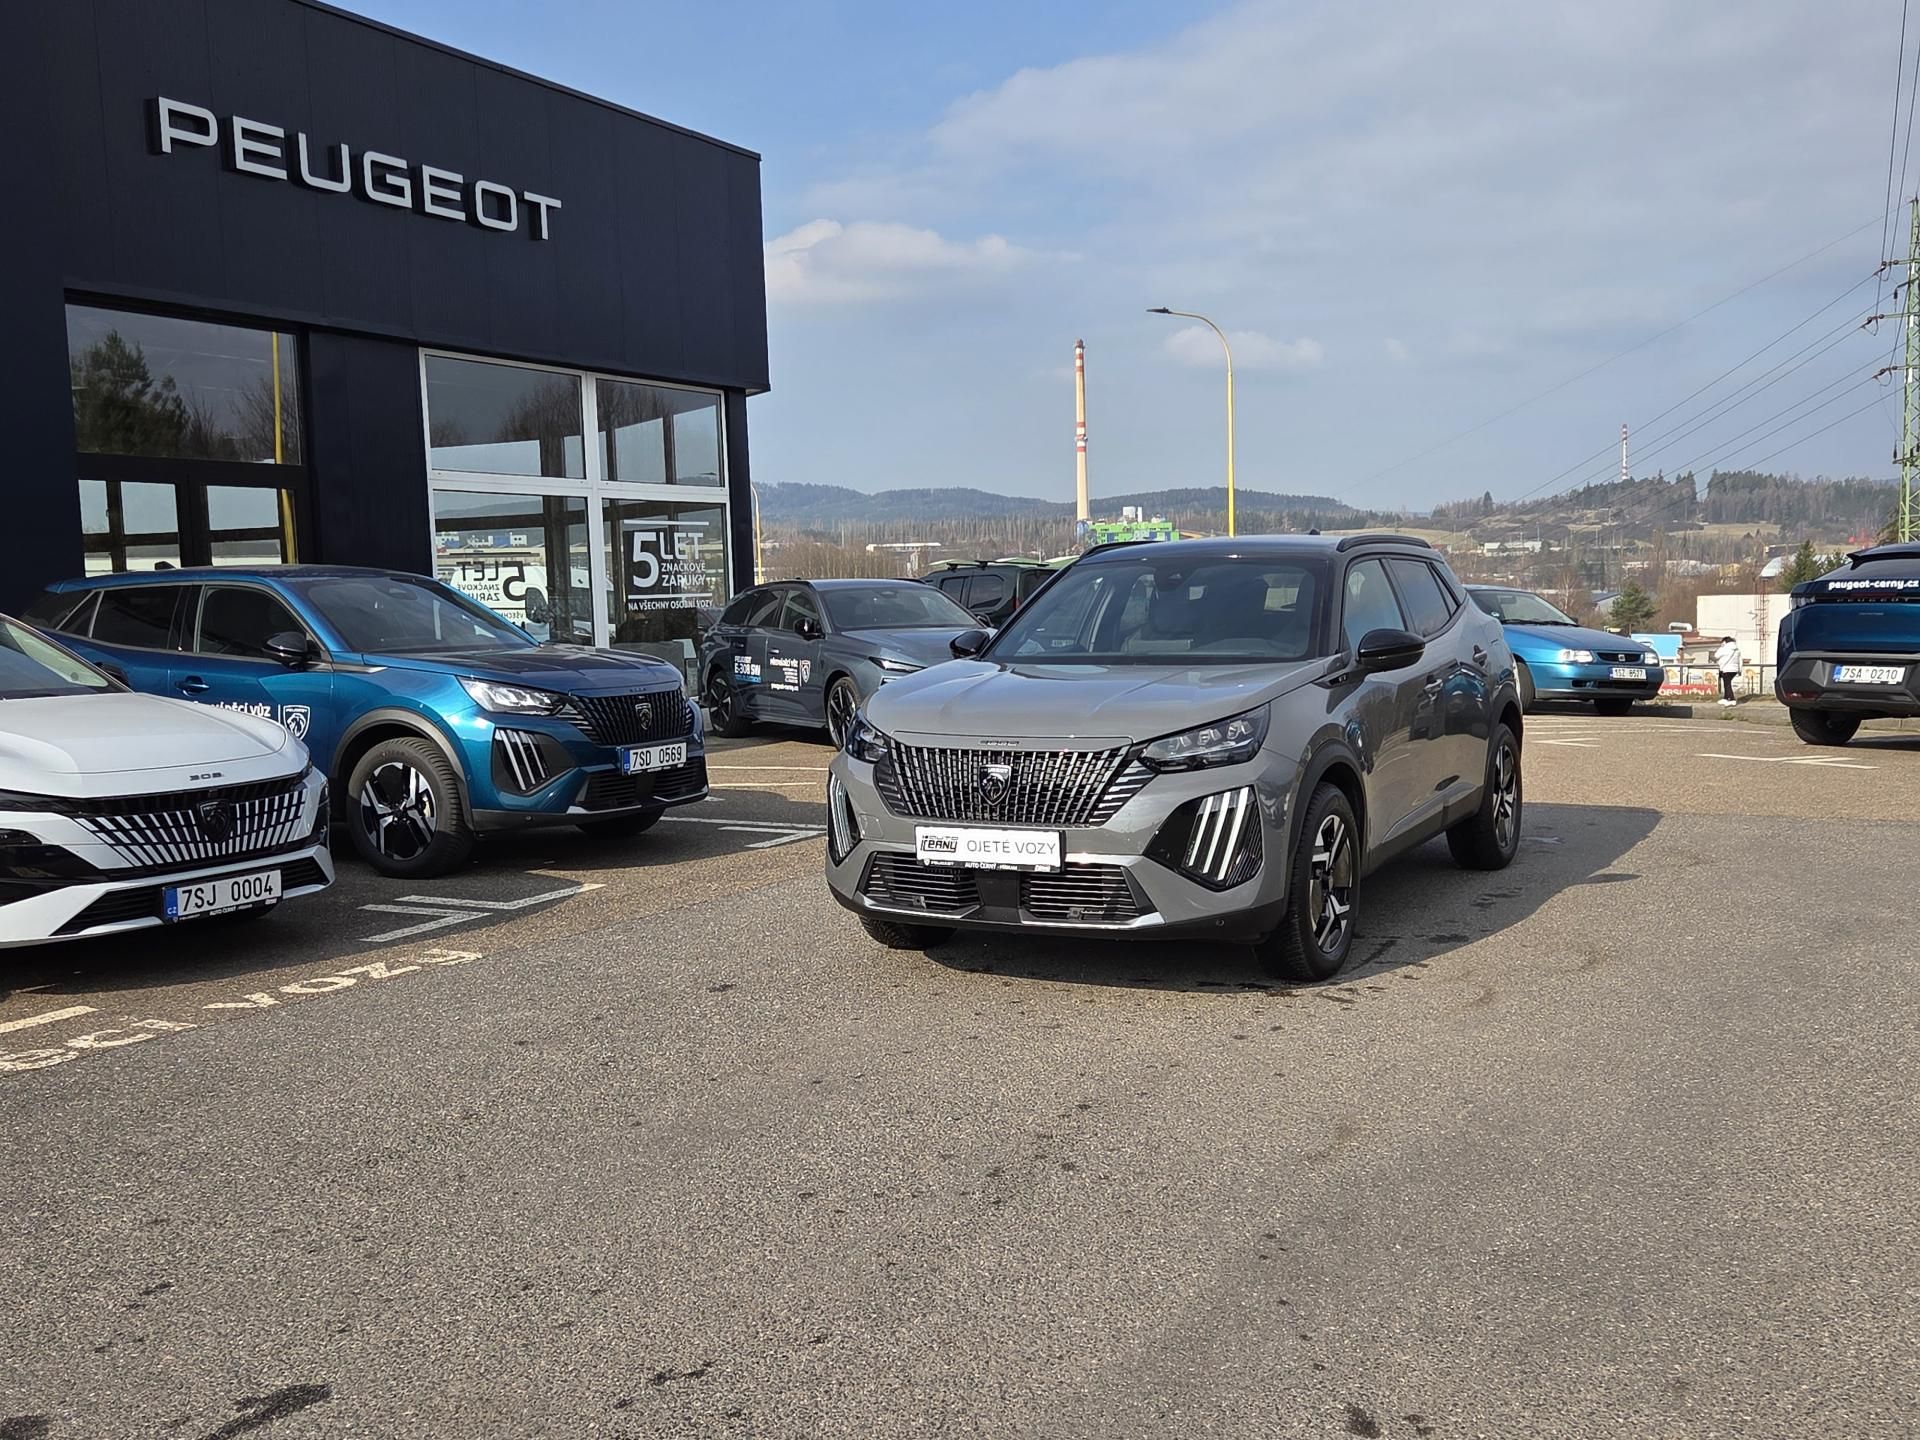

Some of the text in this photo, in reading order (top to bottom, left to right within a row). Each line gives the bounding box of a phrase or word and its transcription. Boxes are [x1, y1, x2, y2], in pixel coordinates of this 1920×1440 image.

[156, 96, 562, 240] PEUGEOT
[633, 532, 704, 588] 5 LET
[1828, 580, 1919, 591] peugeot-cerny.cz
[628, 602, 638, 611] NA
[1842, 668, 1898, 680] 7SA 0210
[632, 746, 682, 769] 7SD 0569
[966, 840, 1057, 855] OJETÉ VOZY
[182, 874, 273, 912] 7SJ 0004
